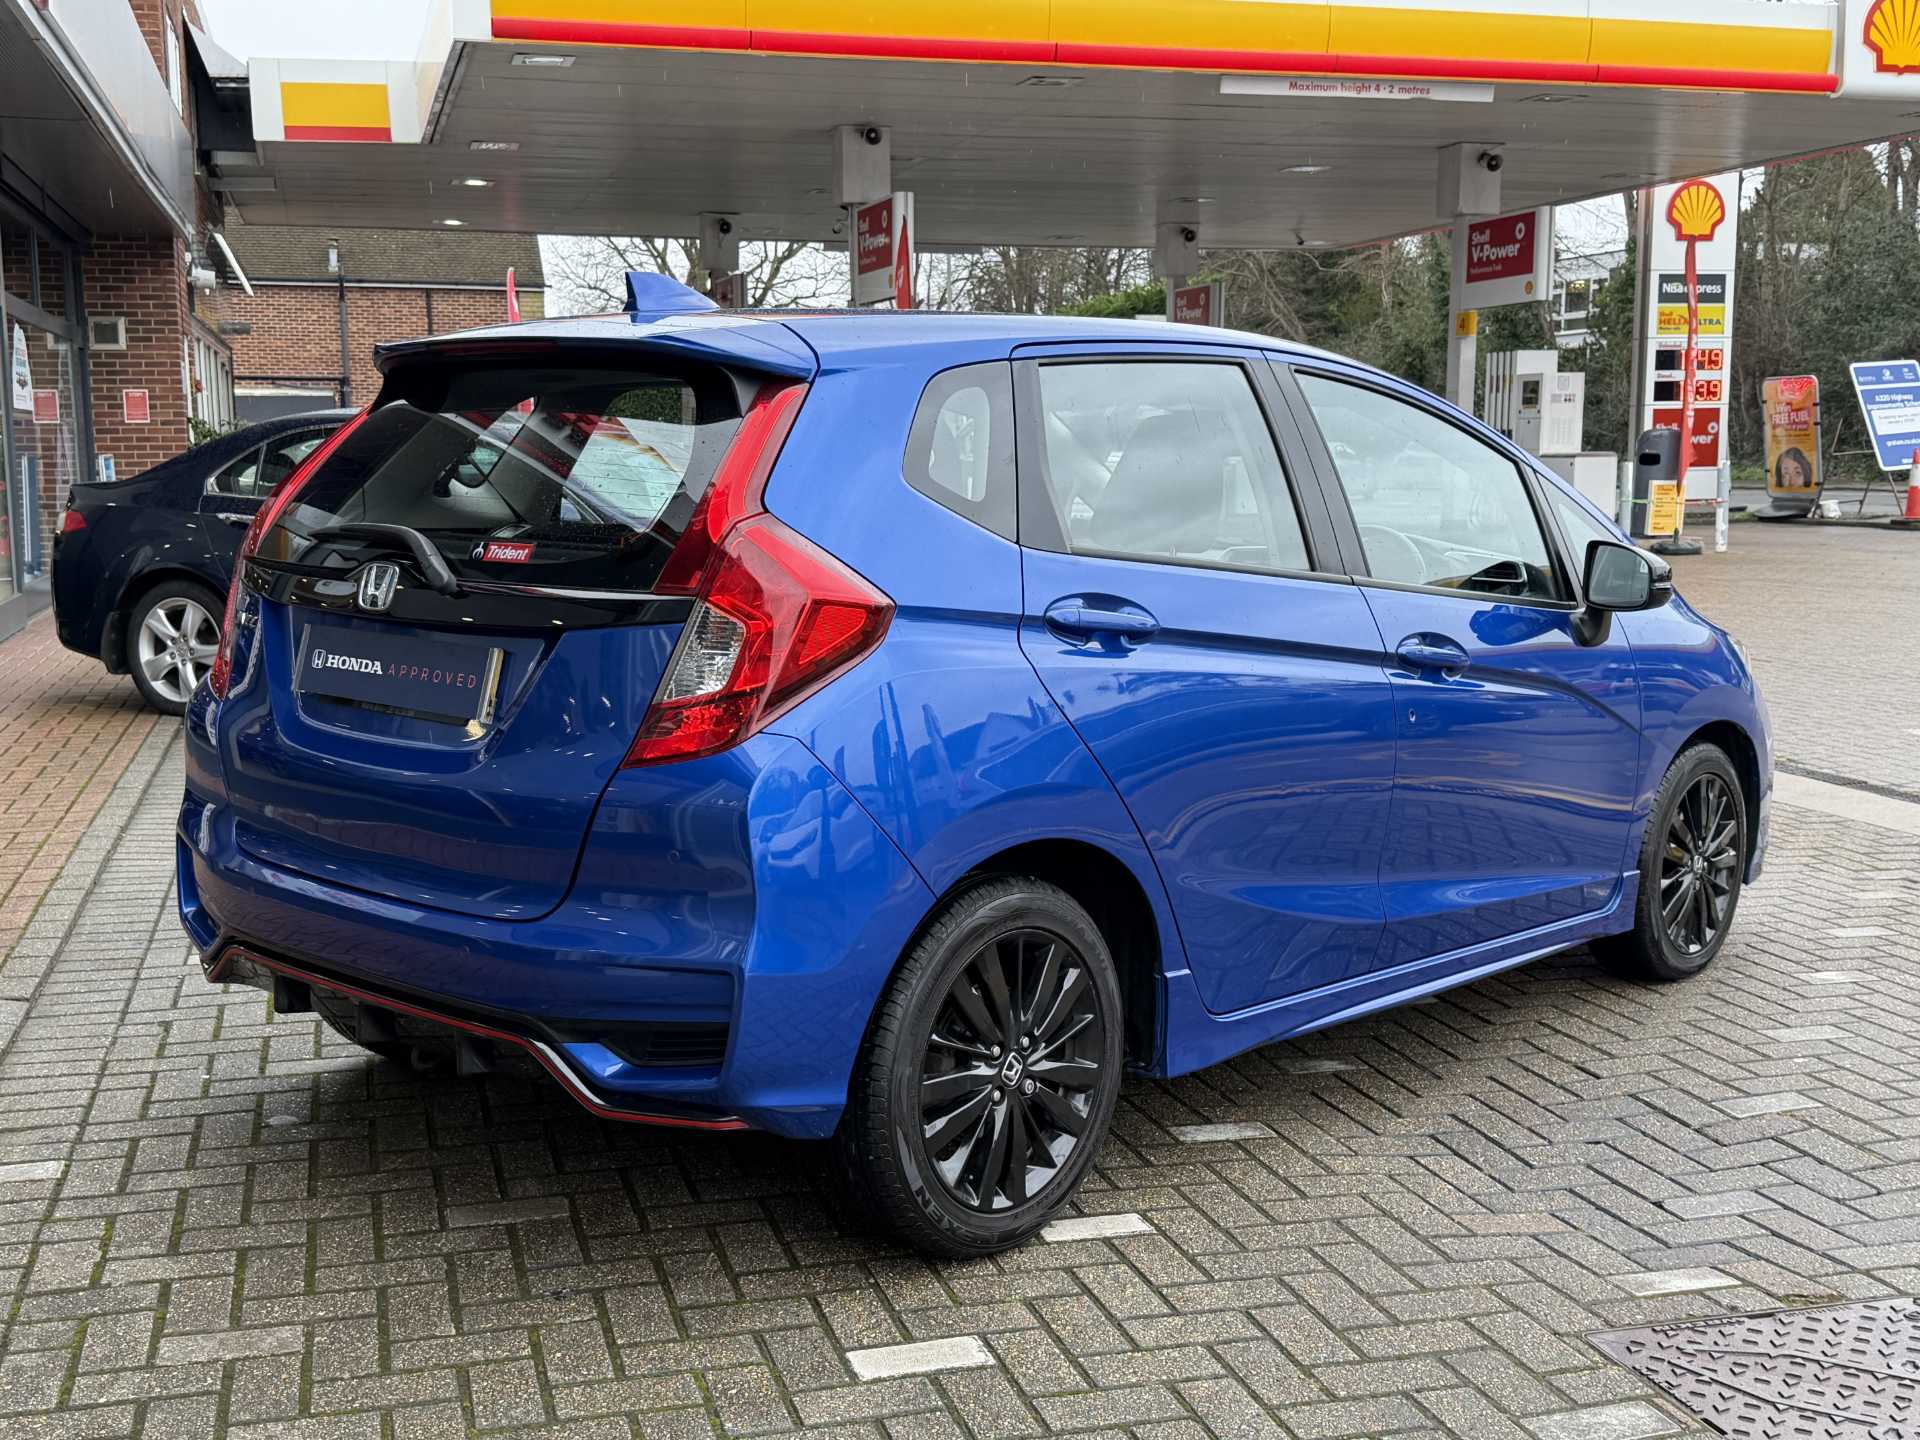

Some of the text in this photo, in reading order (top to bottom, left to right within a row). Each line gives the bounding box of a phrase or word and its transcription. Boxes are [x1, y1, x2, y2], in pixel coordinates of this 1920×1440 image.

[1288, 80, 1338, 93] Maximum
[1340, 81, 1371, 95] height
[1398, 84, 1431, 96] metres
[1471, 229, 1490, 245] Shell
[1472, 243, 1520, 262] V-Power
[1662, 283, 1683, 293] Nisa
[1697, 318, 1721, 326] LTRA
[1681, 349, 1723, 370] 14.9
[1679, 381, 1721, 401] 13.9
[487, 545, 529, 560] Trident
[326, 654, 384, 675] HONDA
[386, 662, 478, 689] APPROVED
